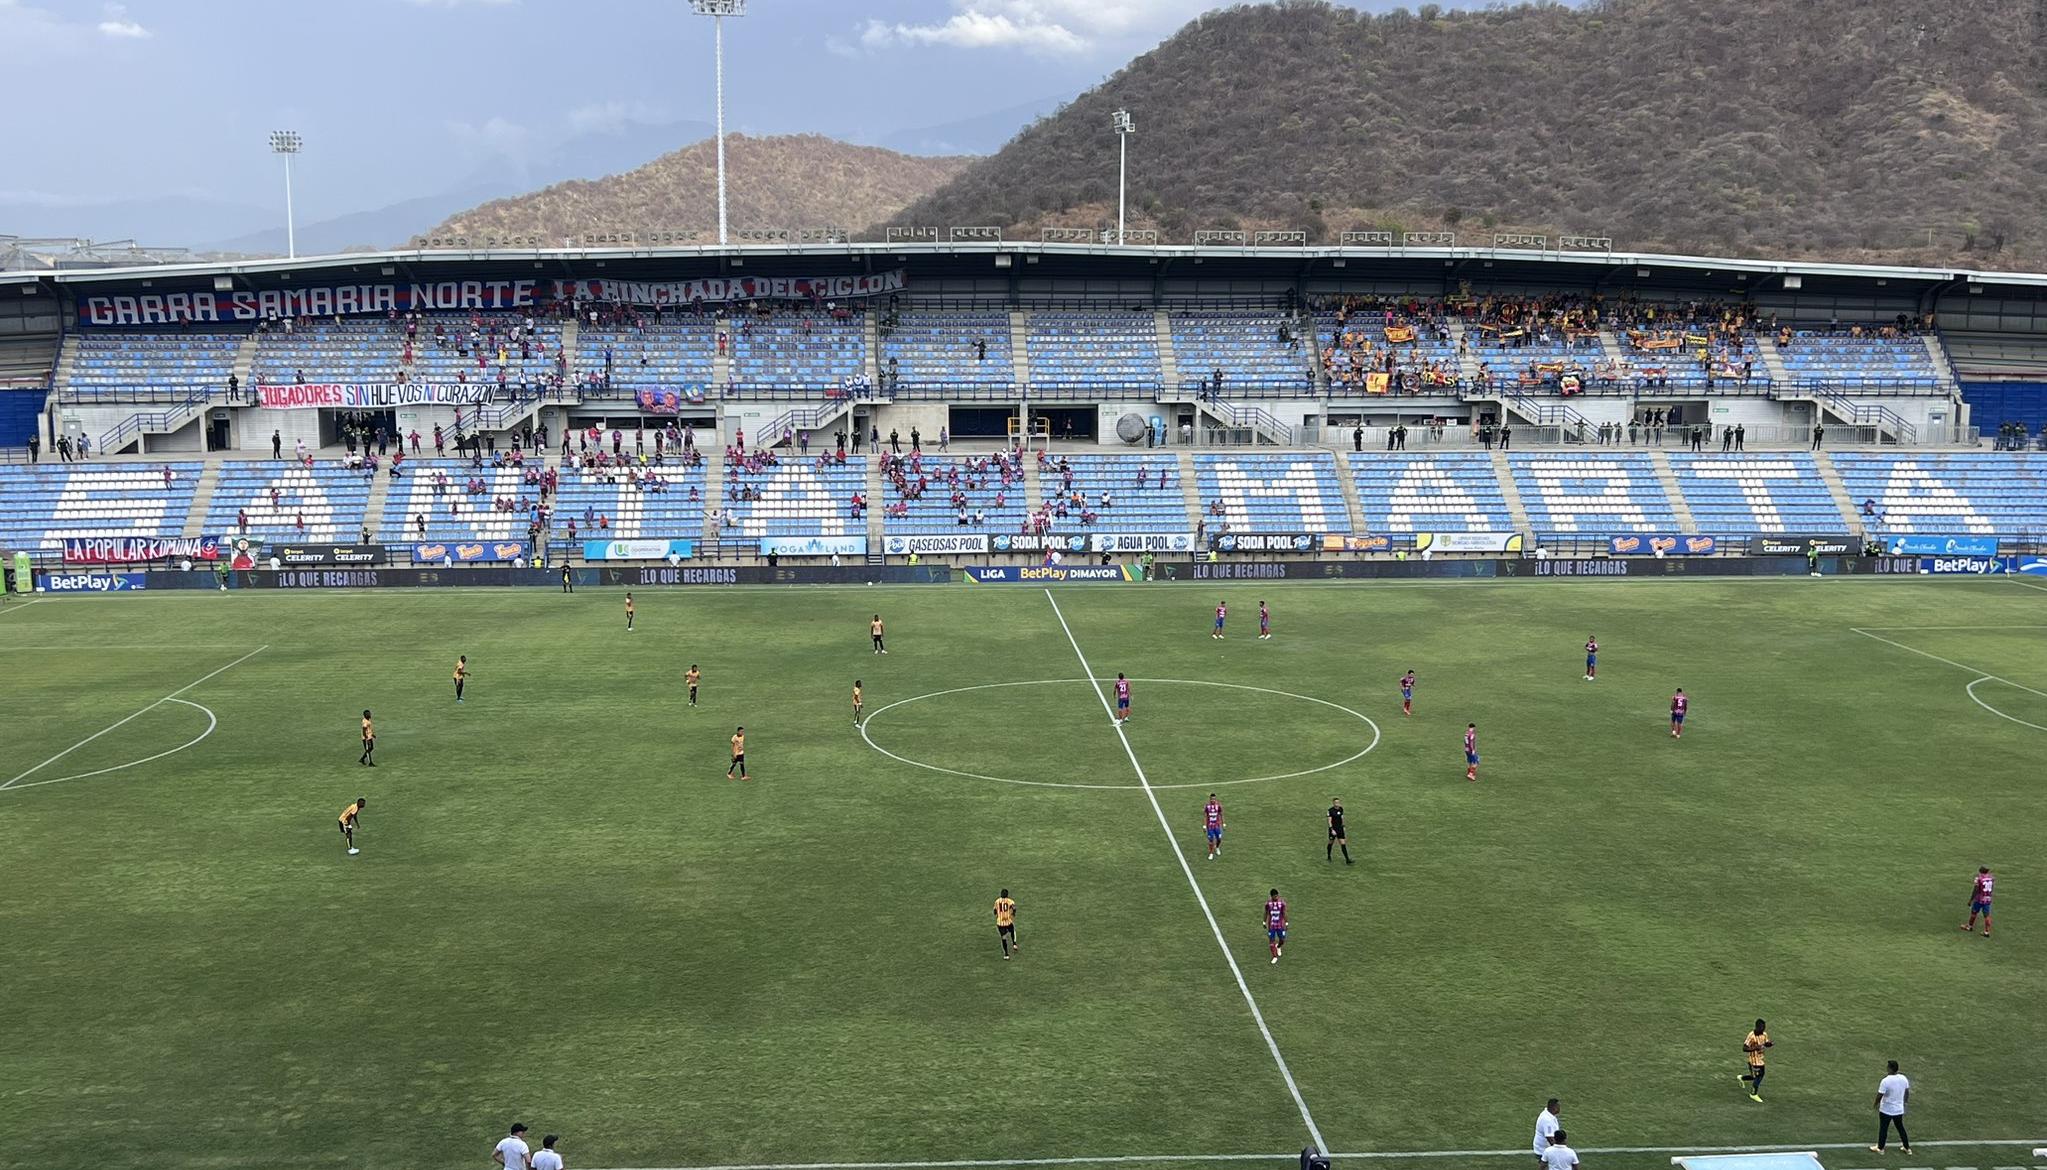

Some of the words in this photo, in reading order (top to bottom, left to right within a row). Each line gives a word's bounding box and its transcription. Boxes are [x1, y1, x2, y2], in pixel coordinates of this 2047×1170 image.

[554, 279, 594, 300] LA
[600, 279, 748, 302] HINCHADA
[754, 277, 799, 299] DEL
[808, 269, 904, 297] CICLON
[88, 292, 219, 325] GARRA
[232, 284, 397, 320] SAMARIA
[409, 279, 537, 310] NORTE
[259, 384, 343, 406] JUGADORES
[347, 385, 369, 406] SIN
[371, 384, 423, 406] HUEVOS
[425, 385, 436, 402] NI
[437, 384, 496, 405] CORAZON
[64, 539, 82, 561] LA
[86, 538, 148, 561] POPULAR
[150, 538, 202, 559] KOMUNA
[205, 542, 215, 551] 5
[826, 545, 856, 553] LAND
[908, 538, 957, 551] GASEOSAS
[959, 537, 984, 550] POOL
[1011, 536, 1039, 549] SODA
[1041, 536, 1067, 549] POOL
[1117, 536, 1142, 550] AGUA
[1145, 536, 1169, 549] POOL
[1237, 536, 1264, 549] SODA
[1266, 536, 1293, 549] POOL
[1212, 565, 1231, 578] QUE
[1234, 565, 1286, 578] RECARGAS
[1553, 561, 1573, 575] QUE
[1576, 561, 1628, 574] RECARGAS
[1893, 559, 1913, 573] QUE
[1934, 559, 1988, 574] BetPlay
[299, 572, 320, 587] QUE
[323, 571, 378, 586] RECARGAS
[660, 569, 680, 584] QUE
[683, 569, 737, 584] RECARGAS
[980, 569, 1006, 578] LIGA
[1020, 568, 1067, 580] BetPlay
[1070, 569, 1117, 578] DIMAYOR
[50, 575, 111, 591] BetPlay
[999, 902, 1008, 912] 10
